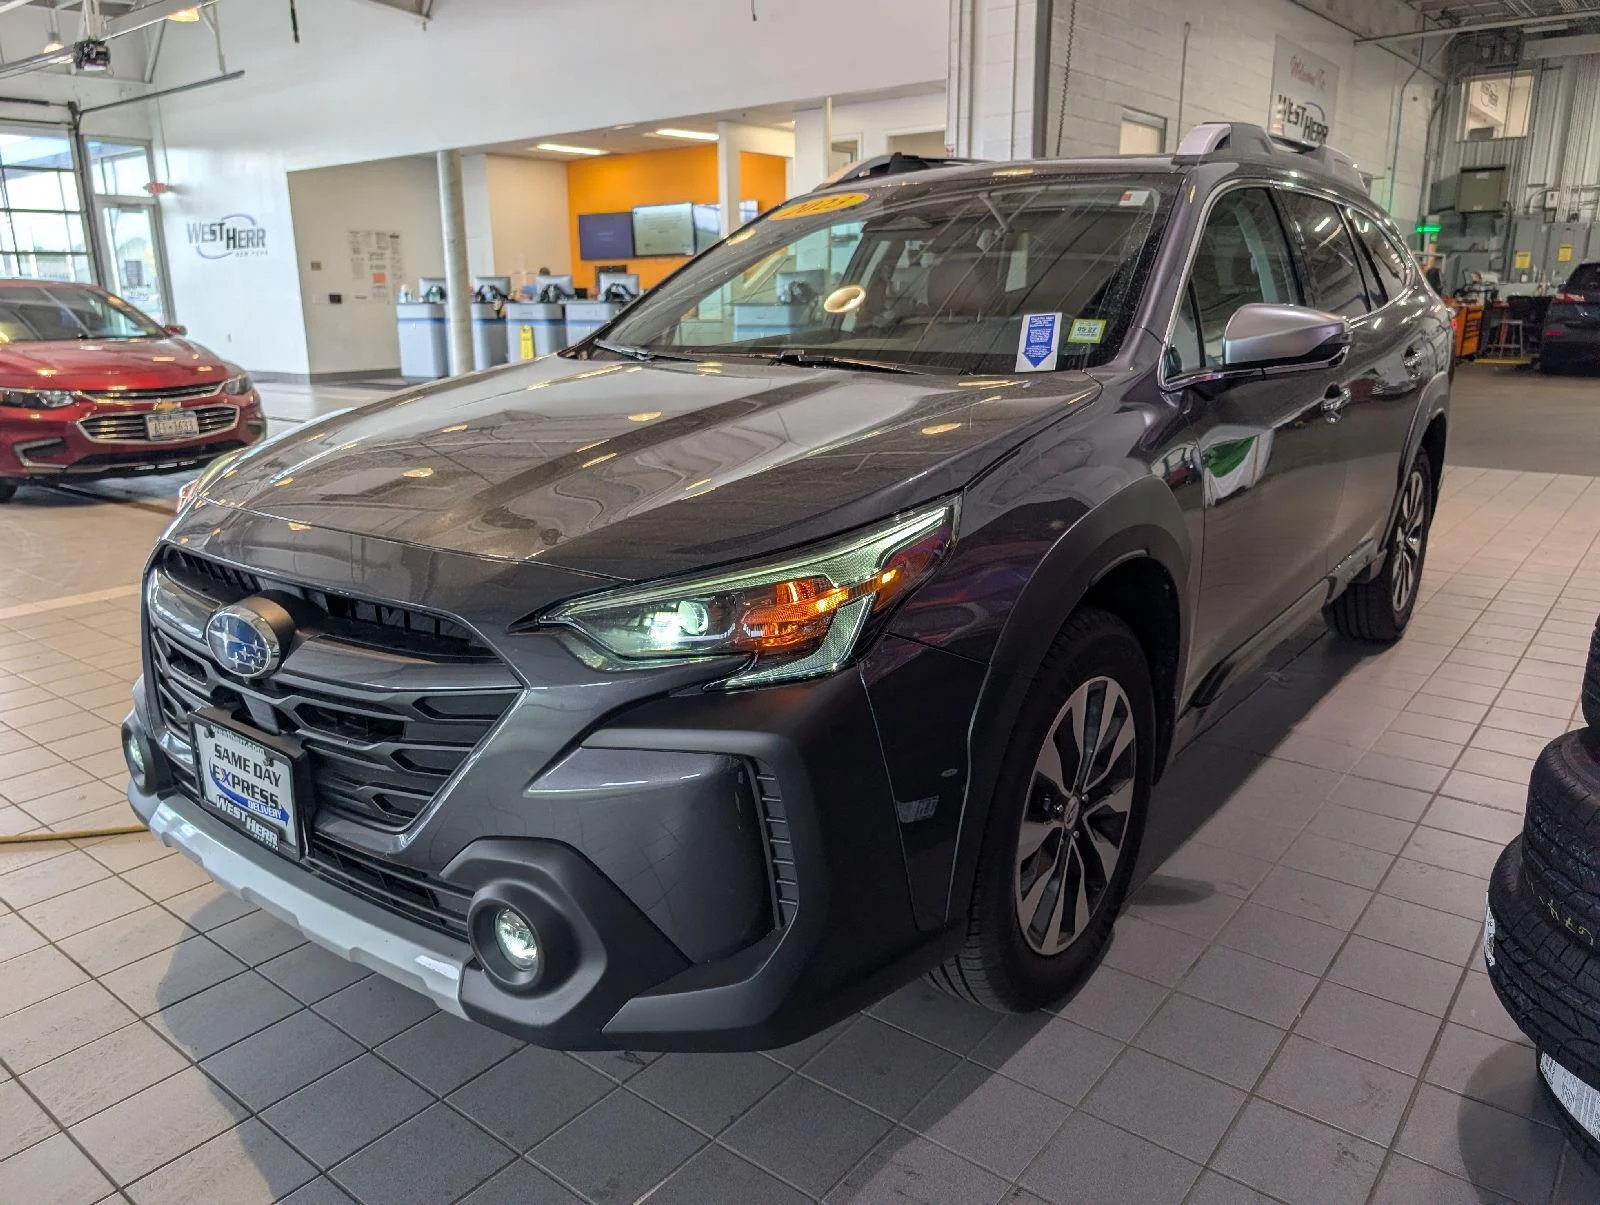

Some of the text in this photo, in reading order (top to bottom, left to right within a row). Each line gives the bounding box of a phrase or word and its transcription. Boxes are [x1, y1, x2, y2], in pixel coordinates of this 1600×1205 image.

[187, 222, 226, 244] WEST
[226, 227, 267, 251] HERR
[214, 743, 281, 788] SAME DAY
[212, 764, 280, 809] EXPRESS
[216, 794, 248, 822] WEST
[247, 800, 282, 819] DELIVERY
[246, 817, 279, 846] HERR
